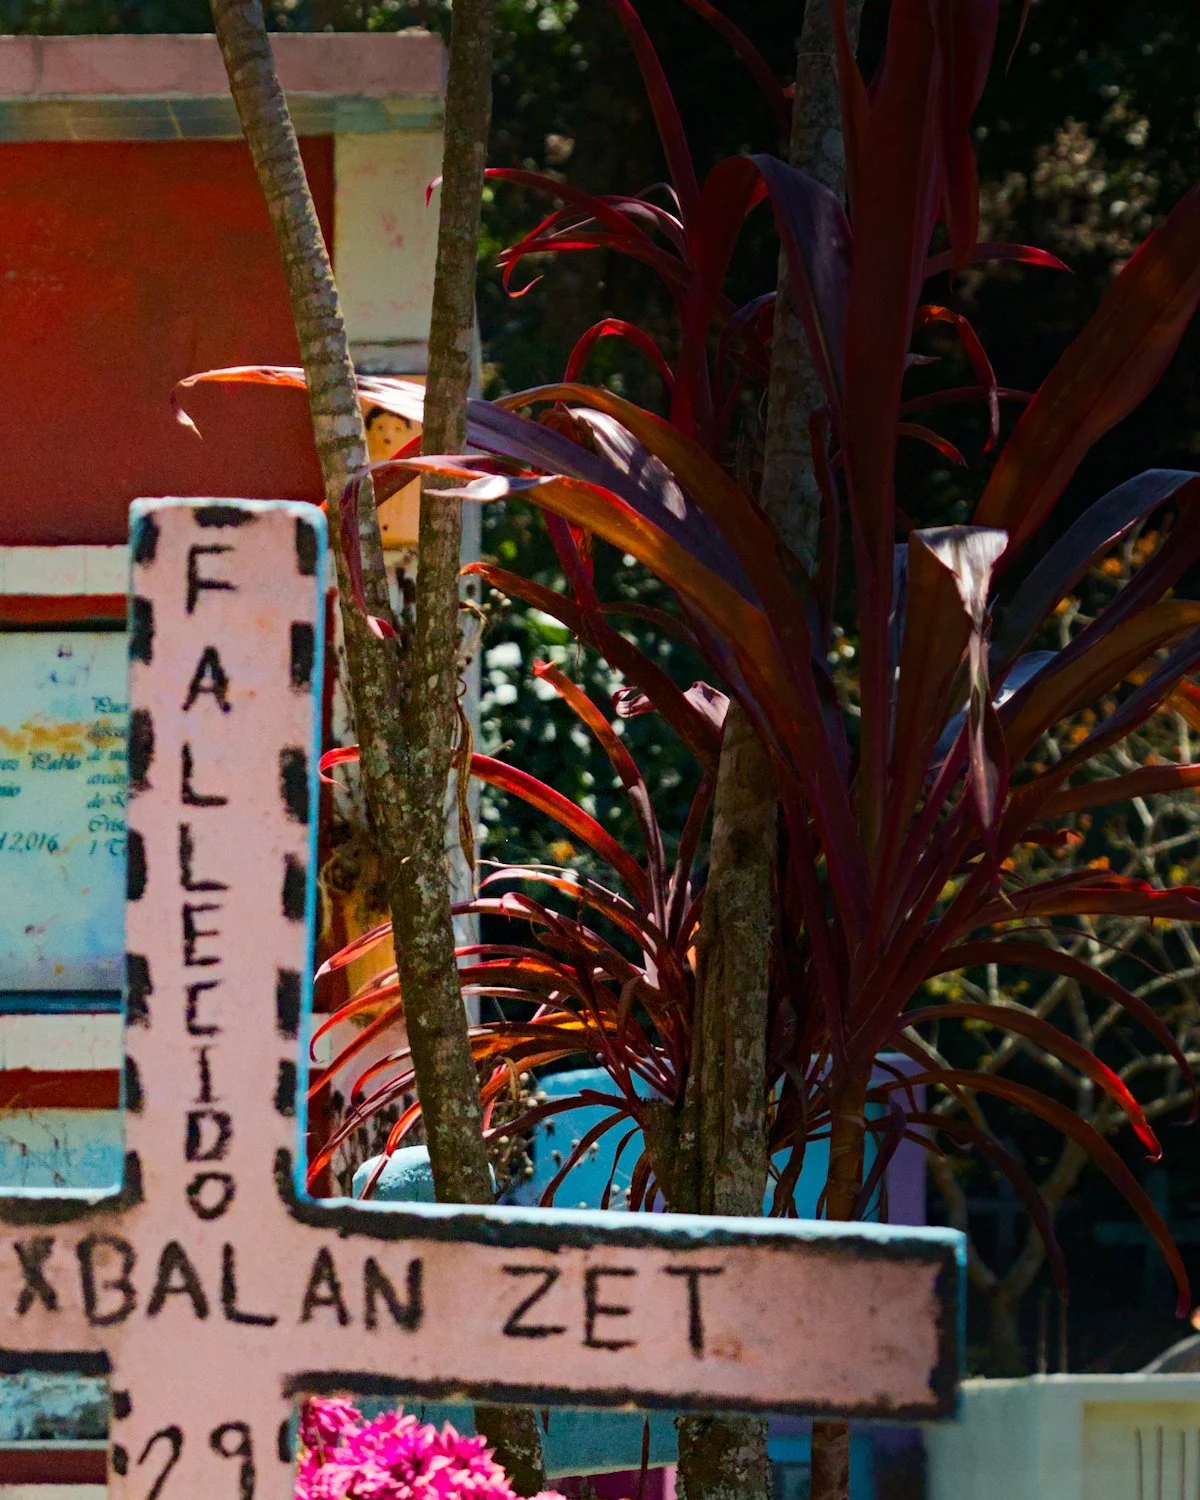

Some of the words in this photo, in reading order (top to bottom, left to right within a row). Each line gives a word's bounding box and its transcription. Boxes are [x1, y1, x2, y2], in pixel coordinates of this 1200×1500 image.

[28, 751, 83, 772] Pablo
[179, 543, 238, 1221] FALLECIDO
[501, 1263, 725, 1359] ZET
